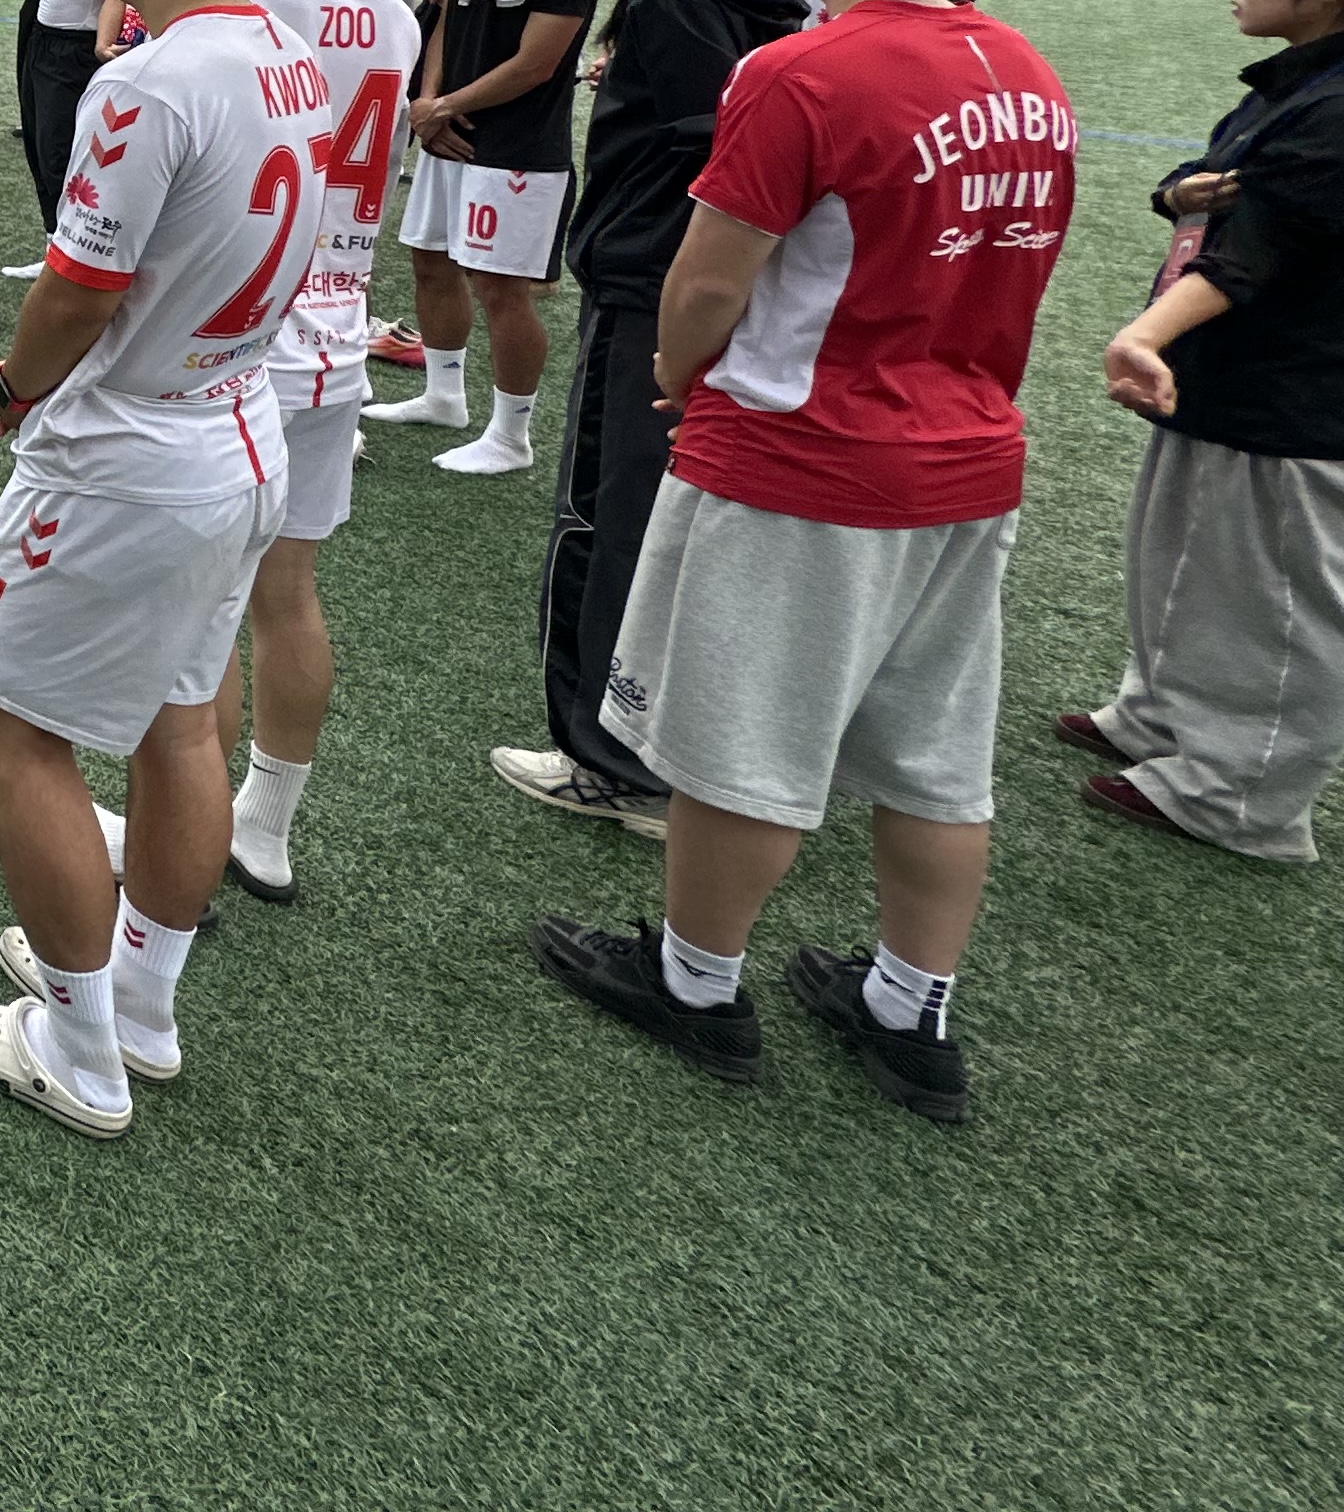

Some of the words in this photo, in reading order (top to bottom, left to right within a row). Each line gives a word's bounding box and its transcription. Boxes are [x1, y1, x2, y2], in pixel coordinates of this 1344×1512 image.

[318, 6, 376, 48] ZOO
[912, 90, 1078, 184] JEONBU
[467, 201, 498, 241] 10
[348, 235, 376, 251] FU
